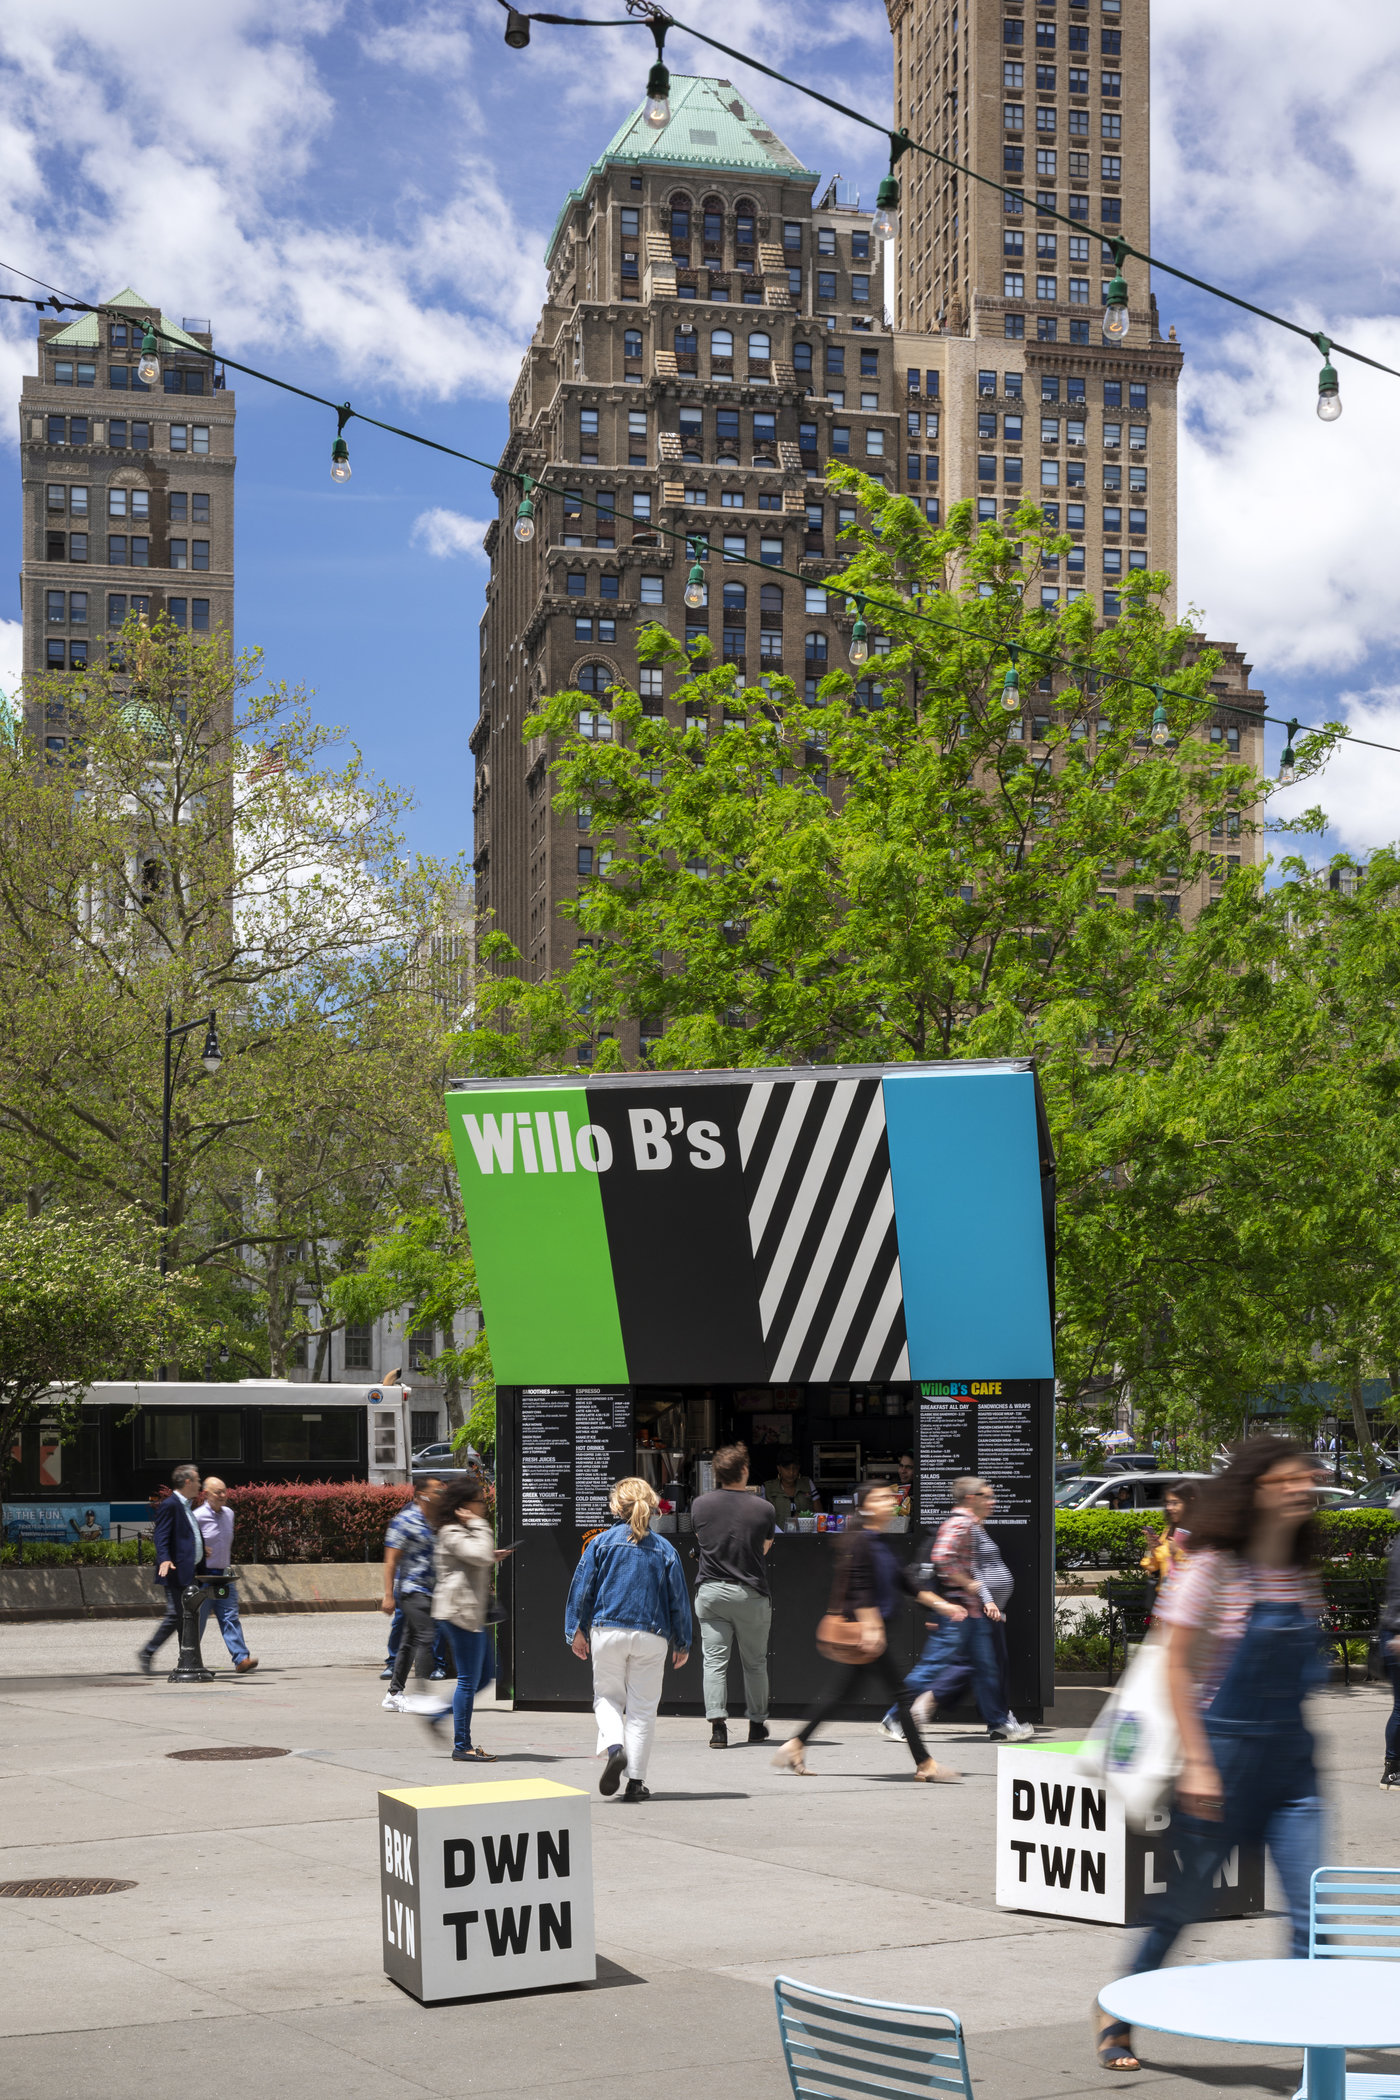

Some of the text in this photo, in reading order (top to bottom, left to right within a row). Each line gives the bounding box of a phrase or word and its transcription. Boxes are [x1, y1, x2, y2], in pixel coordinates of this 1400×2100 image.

[461, 1107, 726, 1175] Willo B's
[920, 1382, 1003, 1396] WilloB's CAFE
[16, 1511, 36, 1520] THE
[39, 1510, 63, 1520] FUN.
[1013, 1778, 1106, 1832] DWN
[384, 1824, 414, 1886] BRK
[443, 1829, 570, 1889] DWN
[1010, 1839, 1106, 1895] TWN
[386, 1894, 416, 1960] LYN
[443, 1901, 572, 1961] TWN
